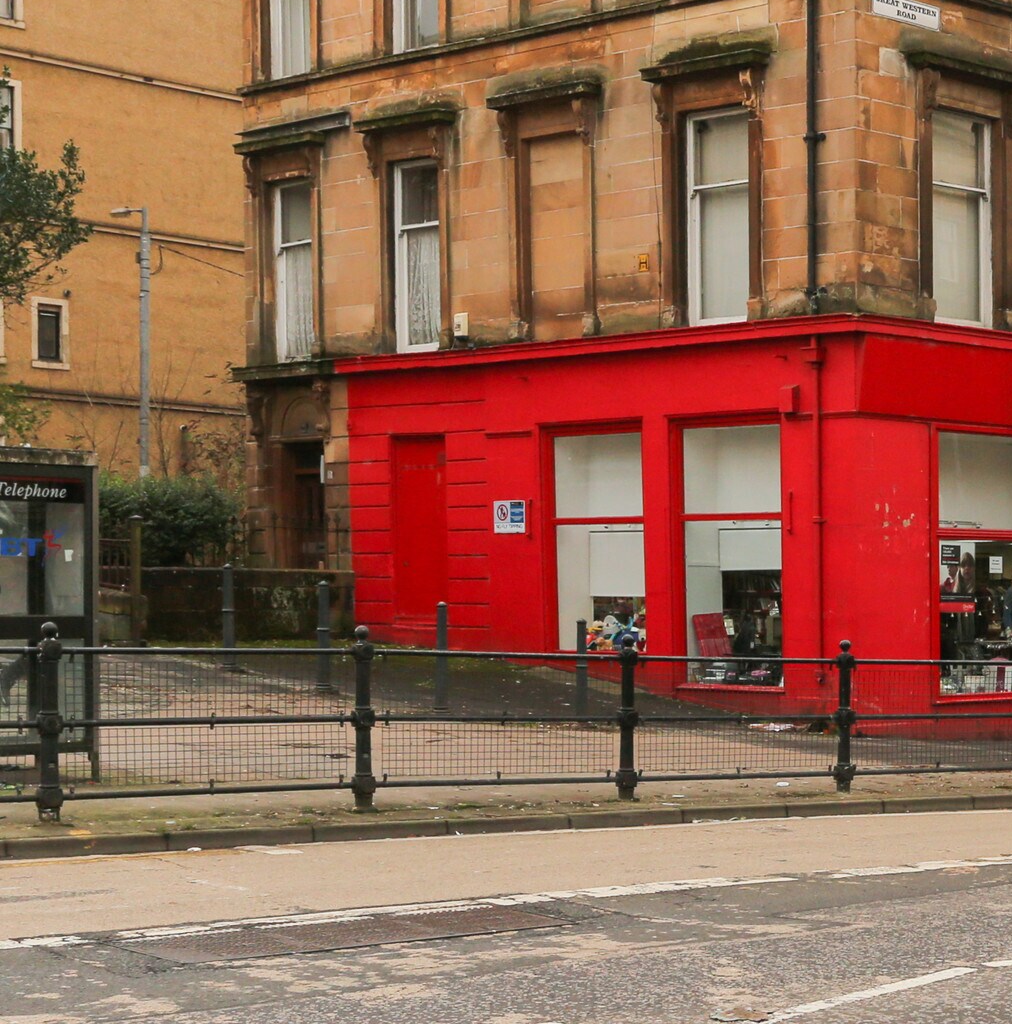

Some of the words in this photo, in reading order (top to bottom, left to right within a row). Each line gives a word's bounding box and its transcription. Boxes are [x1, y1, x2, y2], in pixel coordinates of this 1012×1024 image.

[896, 9, 917, 21] ROAD
[902, 2, 937, 17] WESTERN
[0, 481, 67, 500] Telephone
[1, 537, 43, 557] BT
